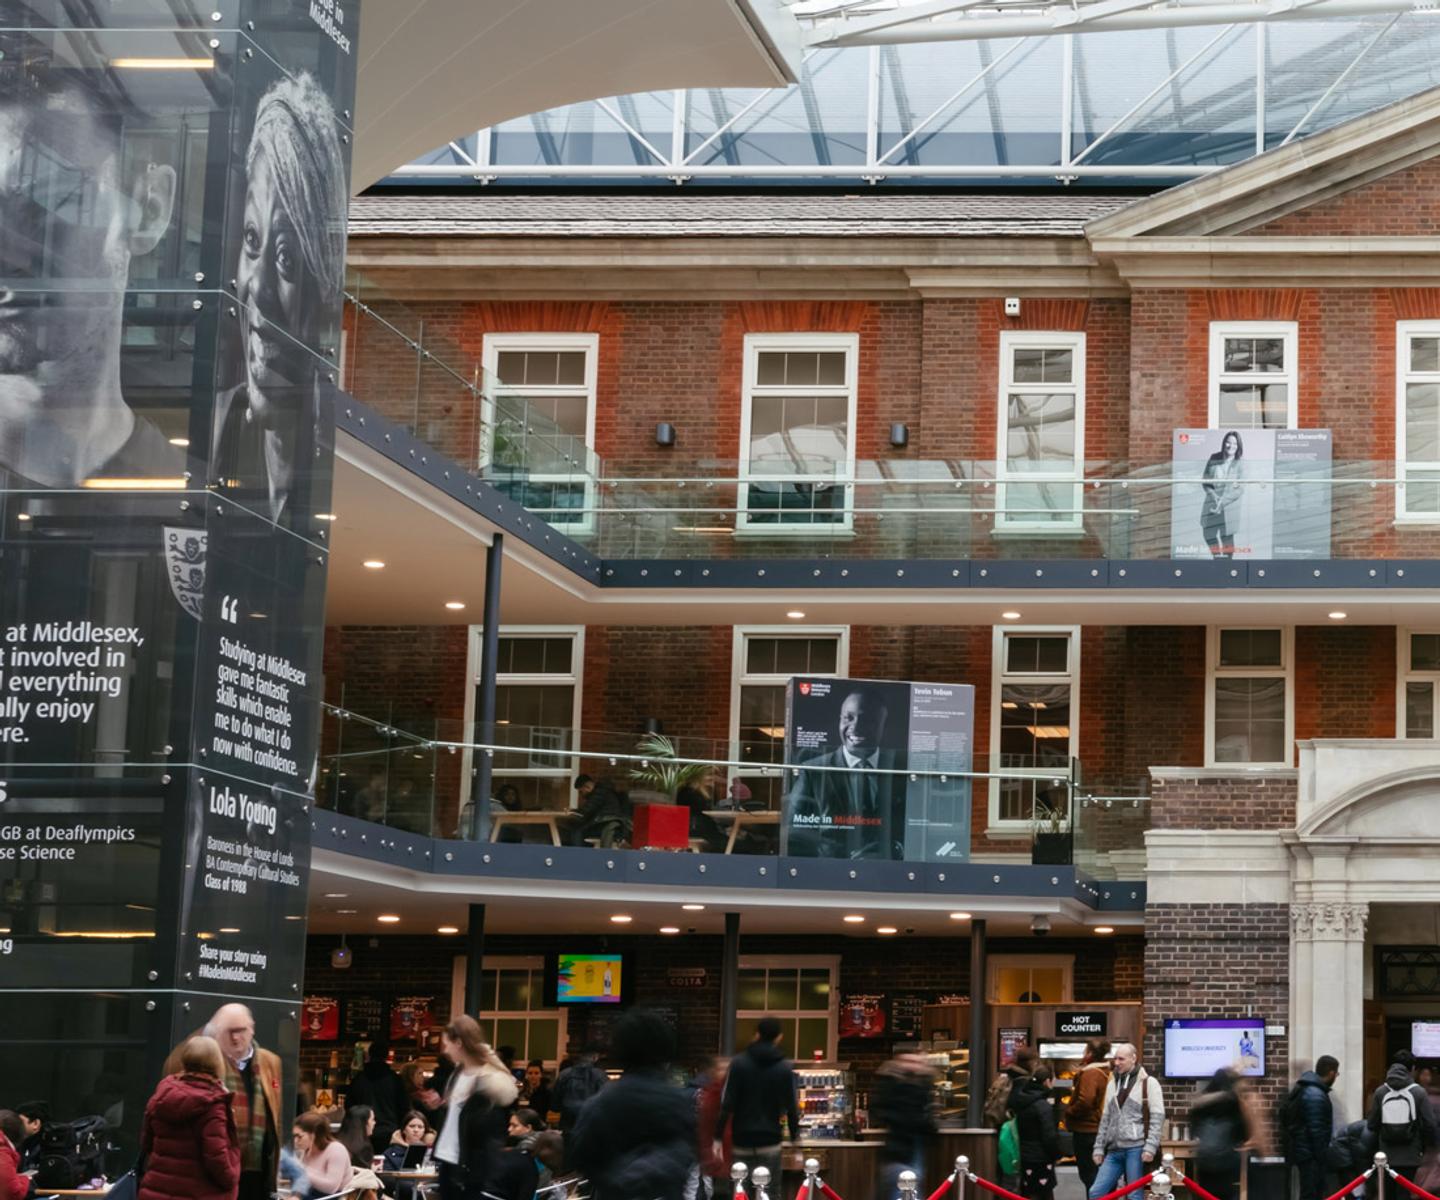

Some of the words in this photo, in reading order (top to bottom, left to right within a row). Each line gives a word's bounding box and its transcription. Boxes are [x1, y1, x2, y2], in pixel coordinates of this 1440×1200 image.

[335, 0, 344, 25] in
[309, 0, 351, 55] Middlesex
[6, 623, 27, 642] at
[33, 621, 144, 647] Middlesex,
[11, 645, 101, 667] involved
[106, 646, 126, 667] in
[219, 636, 257, 672] Studying
[258, 653, 267, 672] at
[267, 655, 307, 686] Middlesex
[9, 670, 122, 697] everything
[218, 664, 239, 684] gave
[240, 672, 255, 690] me
[256, 673, 290, 703] fantastic
[36, 697, 95, 723] enjoy
[216, 683, 238, 709] skills
[239, 693, 264, 718] which
[264, 704, 292, 727] enable
[0, 726, 29, 742] re.
[214, 712, 230, 730] me
[231, 714, 241, 734] to
[241, 717, 253, 738] do
[254, 722, 275, 745] what
[276, 729, 280, 747] I
[280, 730, 292, 751] do
[213, 736, 233, 756] now
[234, 741, 254, 763] with
[254, 748, 299, 776] confidence.
[210, 786, 237, 818] Lola
[239, 793, 277, 835] Young
[793, 813, 820, 824] Made
[822, 814, 832, 825] in
[1, 825, 22, 841] GB
[26, 825, 41, 841] at
[45, 824, 136, 845] Deaflympics
[20, 844, 76, 860] Science
[207, 836, 235, 854] Baroness
[236, 841, 242, 856] in
[243, 842, 253, 858] the
[254, 846, 272, 862] House
[272, 849, 279, 864] of
[279, 851, 294, 867] Lords
[205, 873, 221, 890] Class
[222, 876, 231, 892] of
[231, 878, 248, 894] 1988
[206, 855, 216, 869] BA
[280, 869, 300, 886] Studies
[200, 943, 219, 960] Share
[219, 948, 234, 964] your
[234, 949, 250, 967] story
[250, 950, 267, 969] using
[670, 977, 703, 986] COSTA
[1061, 1024, 1102, 1033] COUNTER
[1072, 1015, 1091, 1024] HOT
